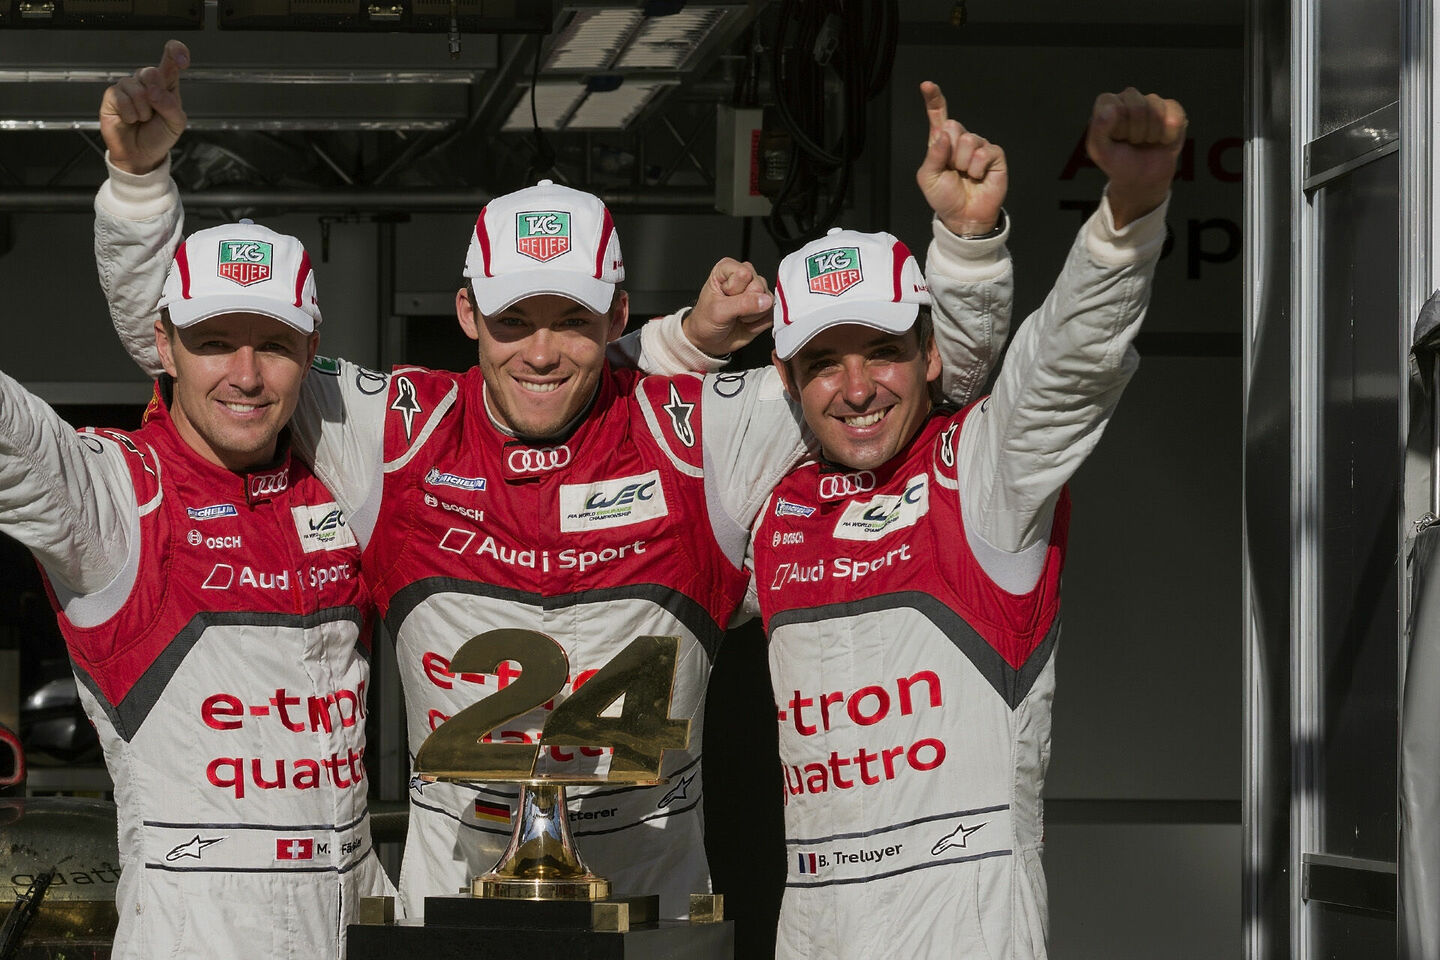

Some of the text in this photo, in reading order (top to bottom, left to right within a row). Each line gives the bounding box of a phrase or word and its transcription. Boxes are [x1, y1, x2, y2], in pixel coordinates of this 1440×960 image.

[526, 214, 562, 235] TAG
[228, 243, 265, 263] TAG
[521, 239, 568, 259] HEUER
[814, 251, 852, 273] TAG
[222, 265, 267, 283] HEUER
[813, 271, 859, 292] HEUER
[586, 479, 657, 510] WEC
[442, 502, 484, 521] BOSCH
[206, 535, 242, 549] OSCH
[782, 531, 804, 545] BOSCH
[477, 537, 647, 572] Audi Sport
[832, 544, 911, 581] Sport
[239, 562, 350, 591] Audi Sport
[413, 628, 692, 778] 24
[777, 670, 942, 737] -tron
[206, 747, 366, 799] quatt
[569, 806, 619, 822] tterer
[316, 843, 331, 855] M.
[833, 844, 903, 865] Treluyer
